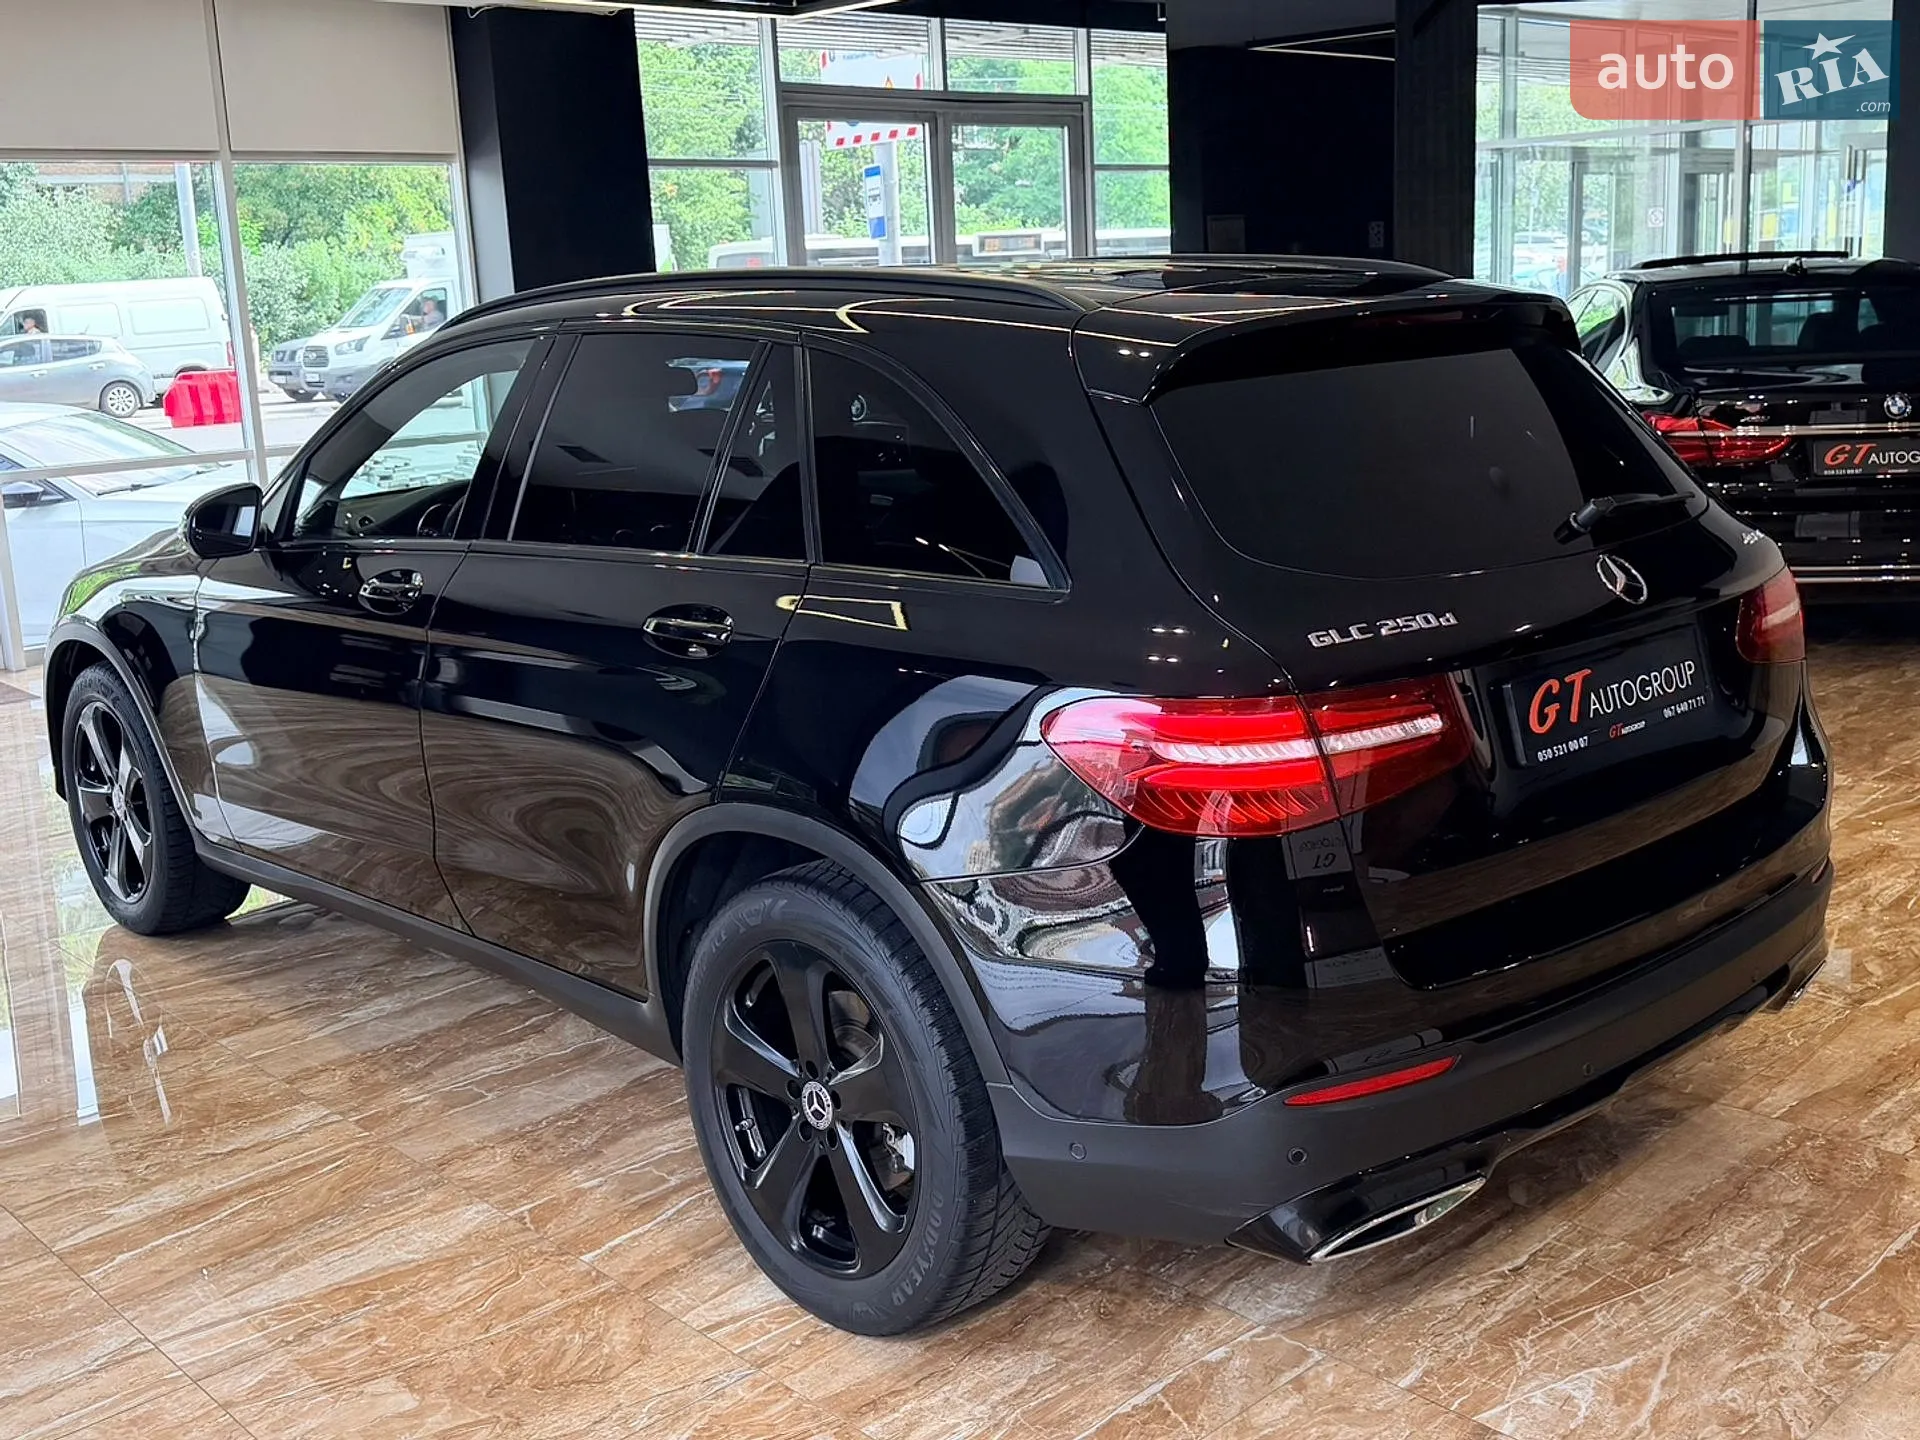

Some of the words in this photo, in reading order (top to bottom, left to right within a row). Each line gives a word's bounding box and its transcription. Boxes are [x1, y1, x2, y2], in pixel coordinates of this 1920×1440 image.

[1823, 443, 1877, 466] GT
[1307, 623, 1374, 648] GLC
[1375, 611, 1459, 637] 250d
[1529, 668, 1592, 734] GT
[1589, 660, 1695, 719] AUTOGROUP
[1662, 706, 1676, 719] 067
[1688, 698, 1697, 711] 71
[1697, 695, 1706, 707] 71
[1537, 748, 1553, 762] 050
[1553, 743, 1567, 757] 521
[1568, 739, 1579, 752] 00
[1578, 735, 1589, 749] 07
